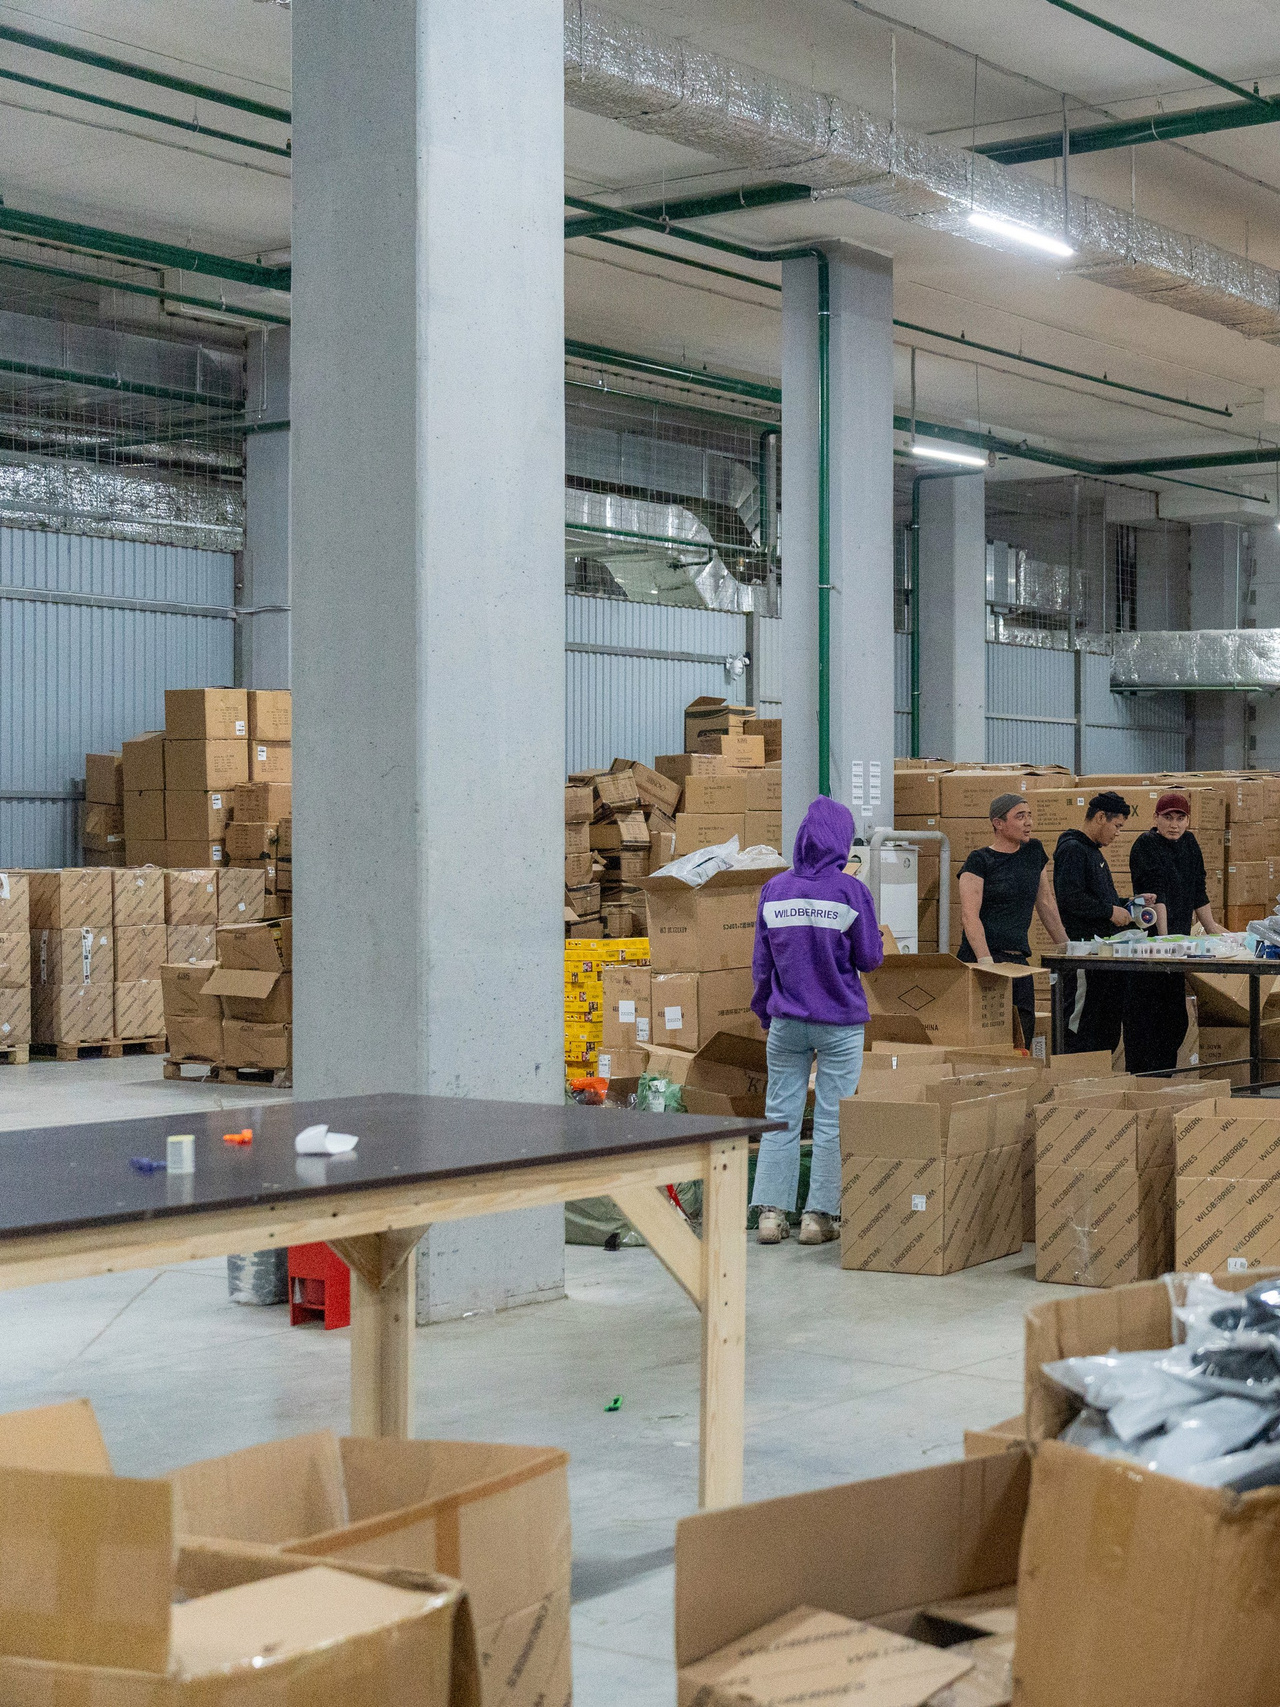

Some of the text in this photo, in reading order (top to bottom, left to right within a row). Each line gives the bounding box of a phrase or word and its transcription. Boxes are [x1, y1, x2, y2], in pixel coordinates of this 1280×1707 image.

[774, 907, 839, 920] WILDBERRIES
[924, 1023, 939, 1031] HINA
[1062, 1126, 1097, 1164] WILDBERRIES
[1207, 1136, 1248, 1177] WILDBERRIES
[868, 1159, 904, 1197] WILDBERRIES
[1092, 1156, 1129, 1194] WILDBERRIES
[1177, 1154, 1198, 1176] ERRIES
[1050, 1171, 1085, 1210] WILDBERRIES
[1195, 1183, 1236, 1223] WILDBERRIES
[858, 1203, 892, 1240] WILDBERRIES
[1233, 1212, 1274, 1253] WILDBERRIES
[890, 1232, 925, 1269] WILDBERRIES
[1182, 1228, 1223, 1269] WILDBERRIES
